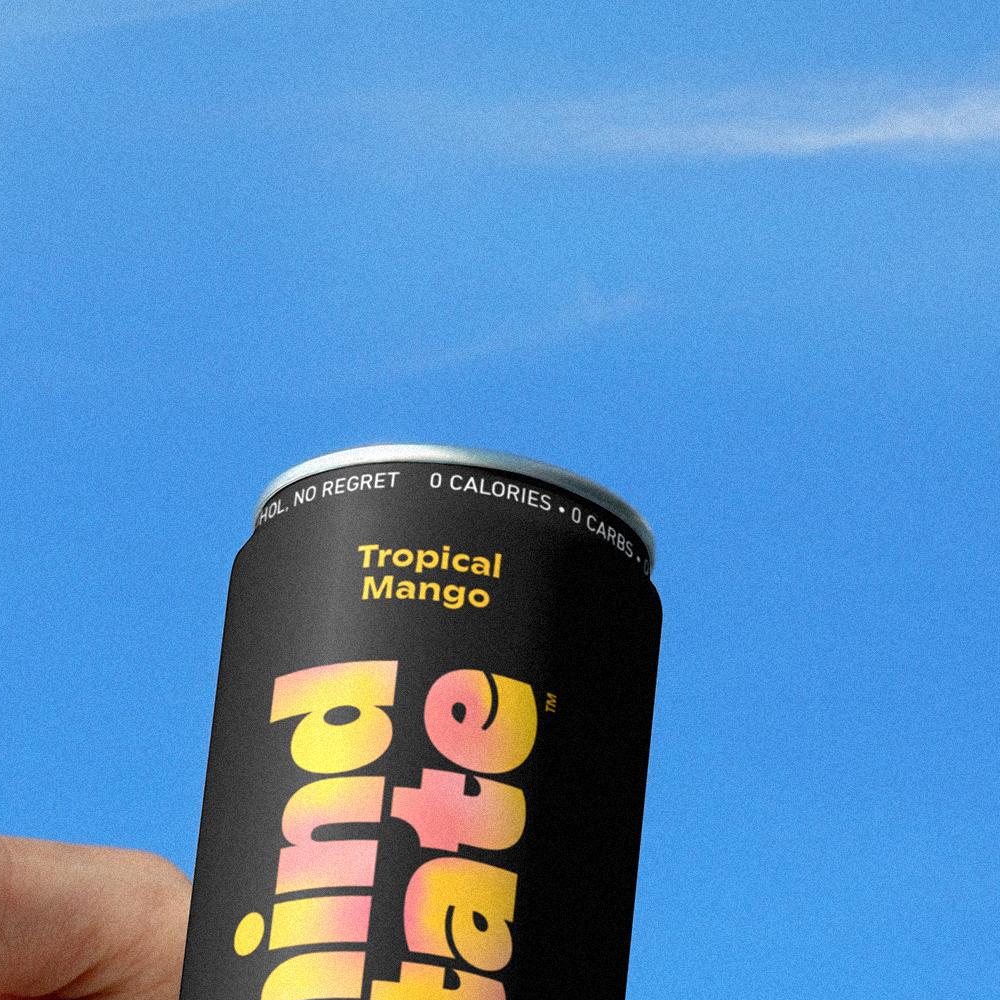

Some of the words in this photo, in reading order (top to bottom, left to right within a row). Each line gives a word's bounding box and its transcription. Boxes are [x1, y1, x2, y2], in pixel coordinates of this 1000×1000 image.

[293, 485, 317, 507] NO
[322, 471, 400, 498] REGRET
[449, 474, 552, 511] CALORIES
[586, 514, 634, 558] CARBS
[358, 544, 502, 578] Tropical
[361, 576, 491, 610] Mango
